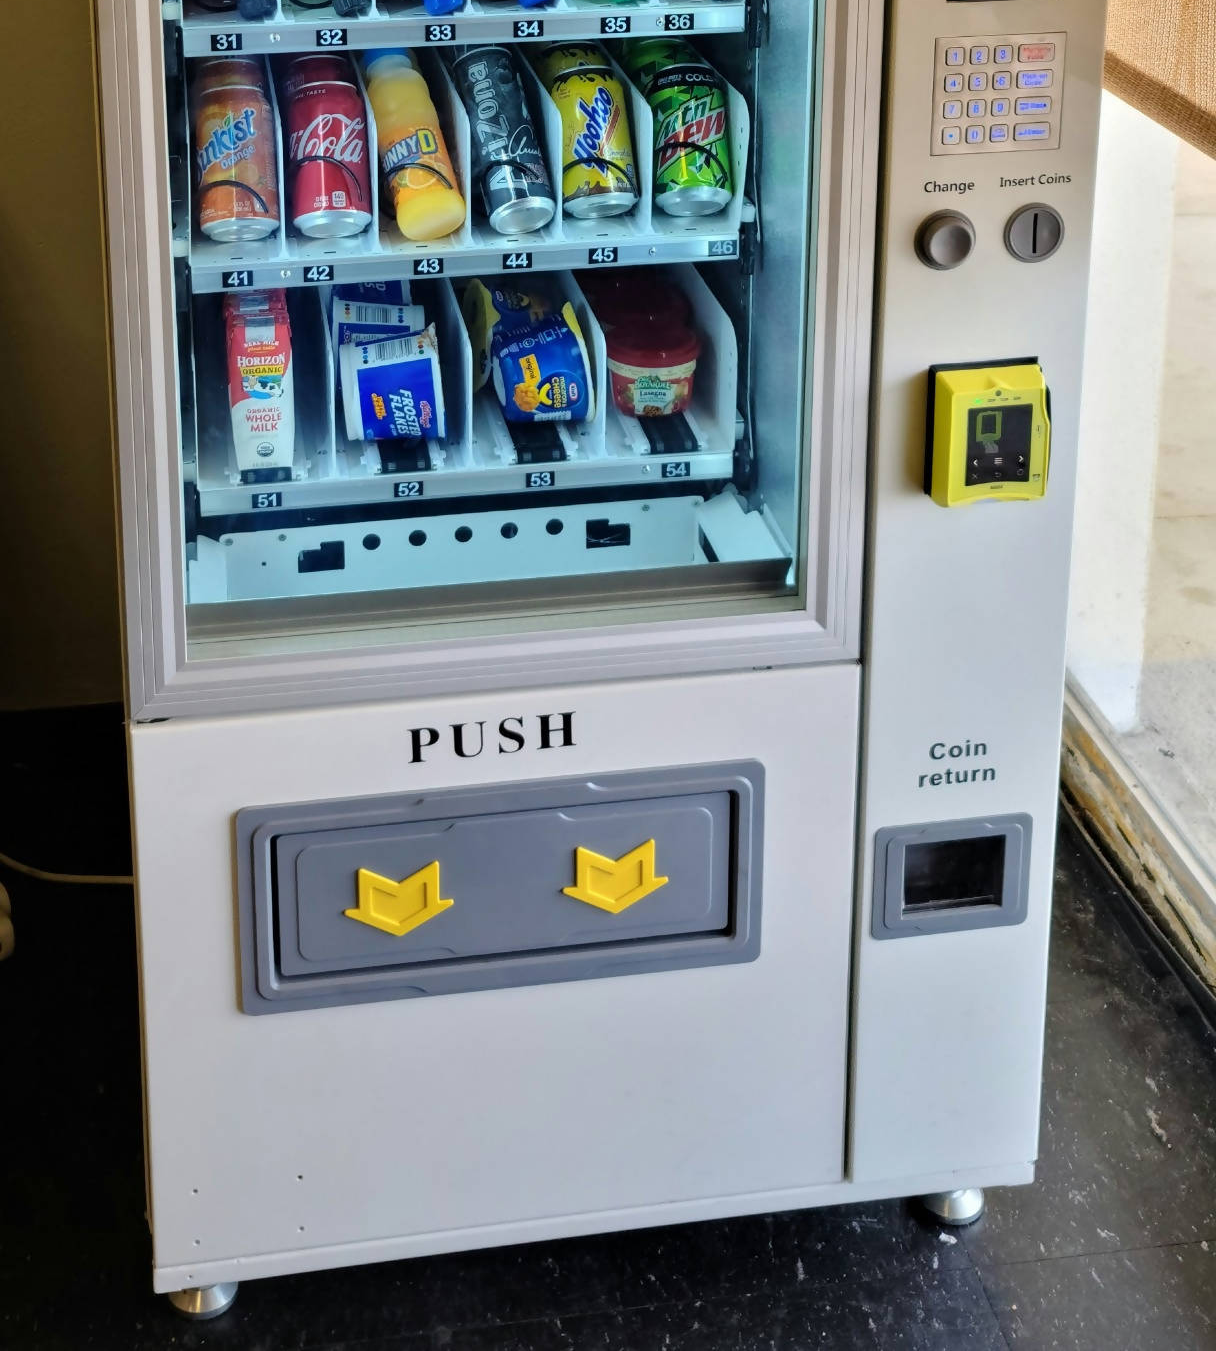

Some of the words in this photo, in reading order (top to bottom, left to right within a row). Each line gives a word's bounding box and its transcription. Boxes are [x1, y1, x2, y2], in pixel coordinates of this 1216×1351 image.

[517, 21, 540, 36] 34
[604, 17, 628, 32] 35
[668, 14, 691, 29] 36
[319, 29, 343, 45] 32
[429, 25, 452, 40] 33
[216, 34, 238, 50] 31
[221, 144, 255, 169] Orange
[383, 128, 439, 173] UNNYD
[924, 180, 975, 195] Change
[999, 176, 1035, 188] Insert
[1038, 173, 1072, 185] Coins
[592, 248, 614, 262] 45
[712, 241, 734, 254] 46
[417, 259, 440, 273] 43
[505, 254, 528, 267] 44
[227, 271, 249, 286] 41
[307, 266, 330, 280] 42
[237, 352, 286, 367] HORIZON
[242, 366, 283, 375] ORGANIC
[245, 412, 282, 423] WHOLE
[388, 394, 410, 434] FLAKES
[399, 389, 422, 436] FROSTED
[250, 422, 278, 432] MILK
[666, 463, 687, 477] 54
[529, 472, 551, 486] 53
[398, 482, 420, 496] 52
[257, 494, 277, 507] 51
[407, 710, 577, 764] PUSH
[928, 738, 988, 762] Coin
[917, 764, 997, 789] return
